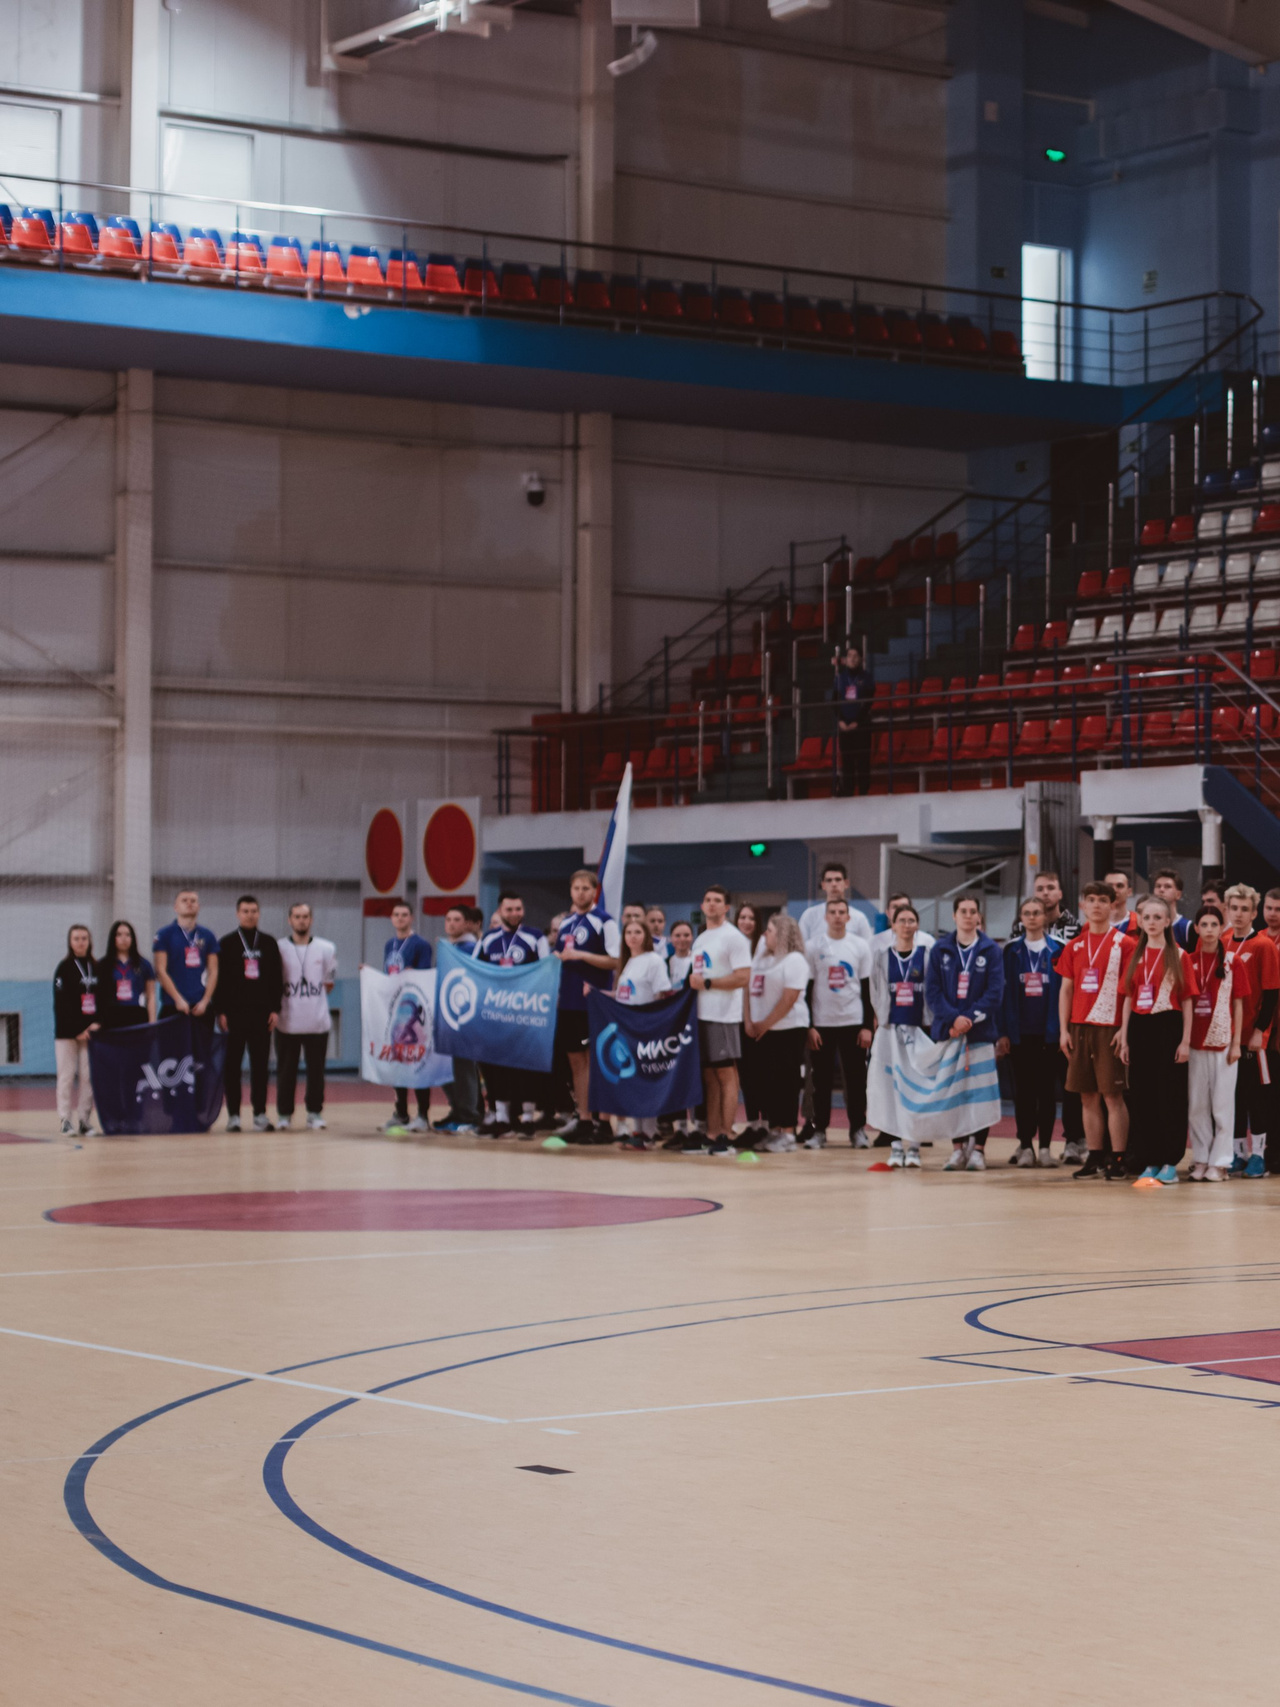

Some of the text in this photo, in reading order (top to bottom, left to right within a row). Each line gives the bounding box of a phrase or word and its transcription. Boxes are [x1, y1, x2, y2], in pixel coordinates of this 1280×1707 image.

[483, 987, 551, 1013] МИСИС
[481, 1009, 547, 1027] СТАРЫЙ ОСКОЛ
[136, 1054, 204, 1090] АСС
